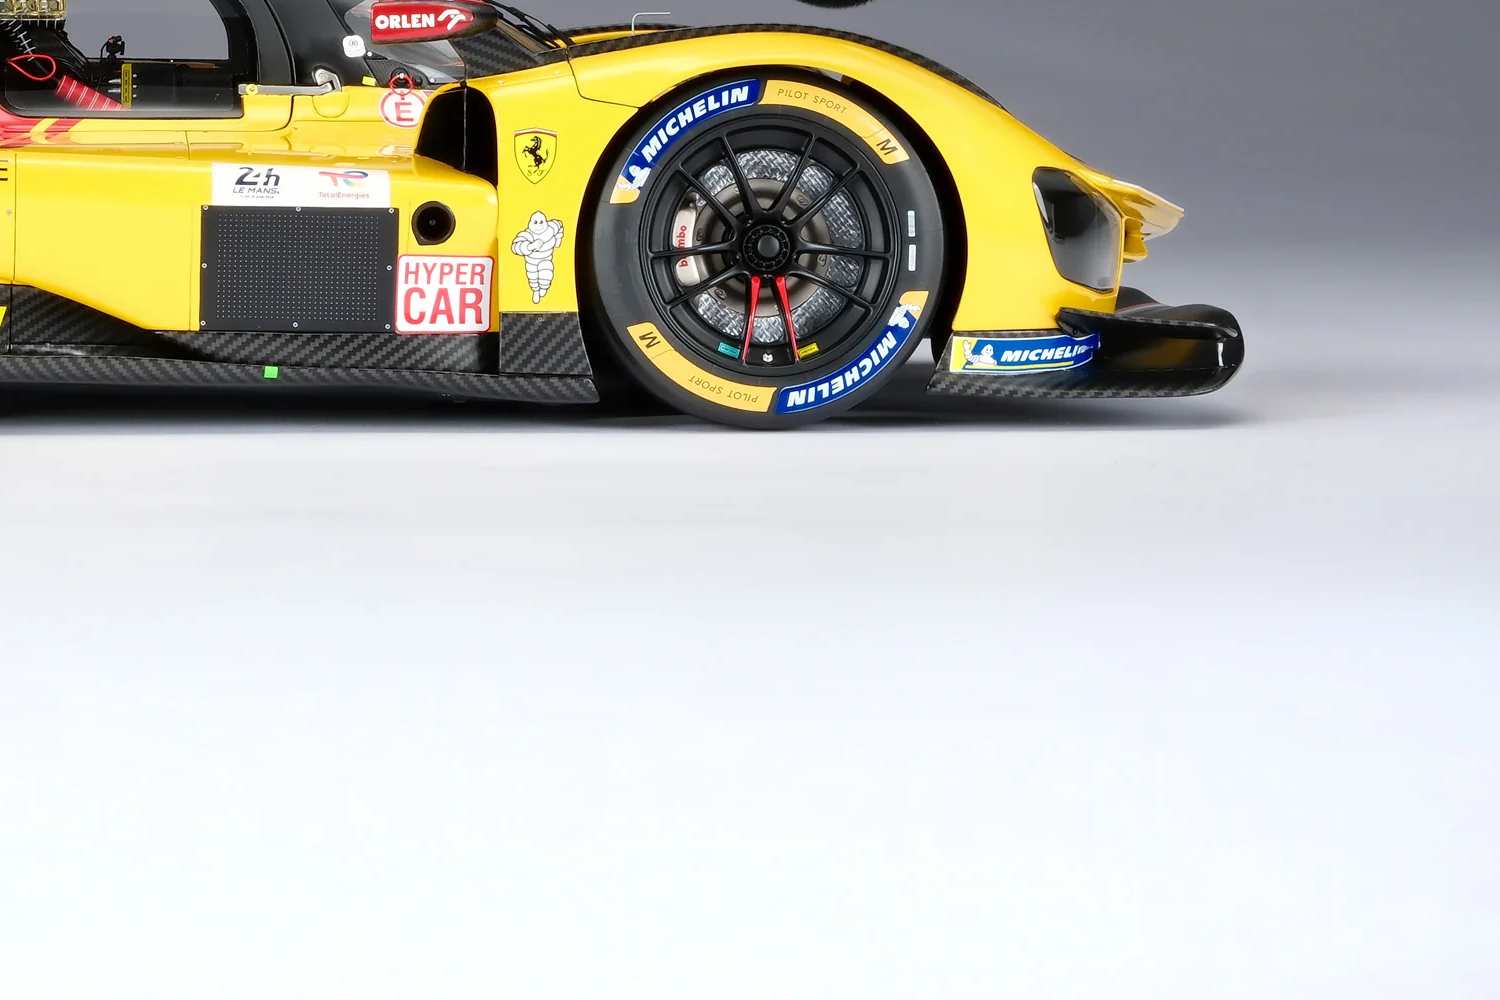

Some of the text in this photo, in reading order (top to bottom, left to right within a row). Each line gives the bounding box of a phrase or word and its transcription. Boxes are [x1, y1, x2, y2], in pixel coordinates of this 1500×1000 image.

[374, 13, 435, 30] ORLEN
[394, 101, 414, 122] E
[777, 88, 848, 114] PILOT SPORT
[640, 85, 749, 163] MICHELIN
[876, 138, 898, 156] M
[232, 186, 278, 195] LE MANS
[319, 191, 370, 200] TotalEnergies
[676, 225, 689, 267] bmbo
[404, 262, 486, 285] HYPER
[403, 287, 484, 325] CAR
[638, 331, 661, 349] M
[786, 330, 898, 408] MICHELIN
[688, 374, 759, 403] PILOT SPORT
